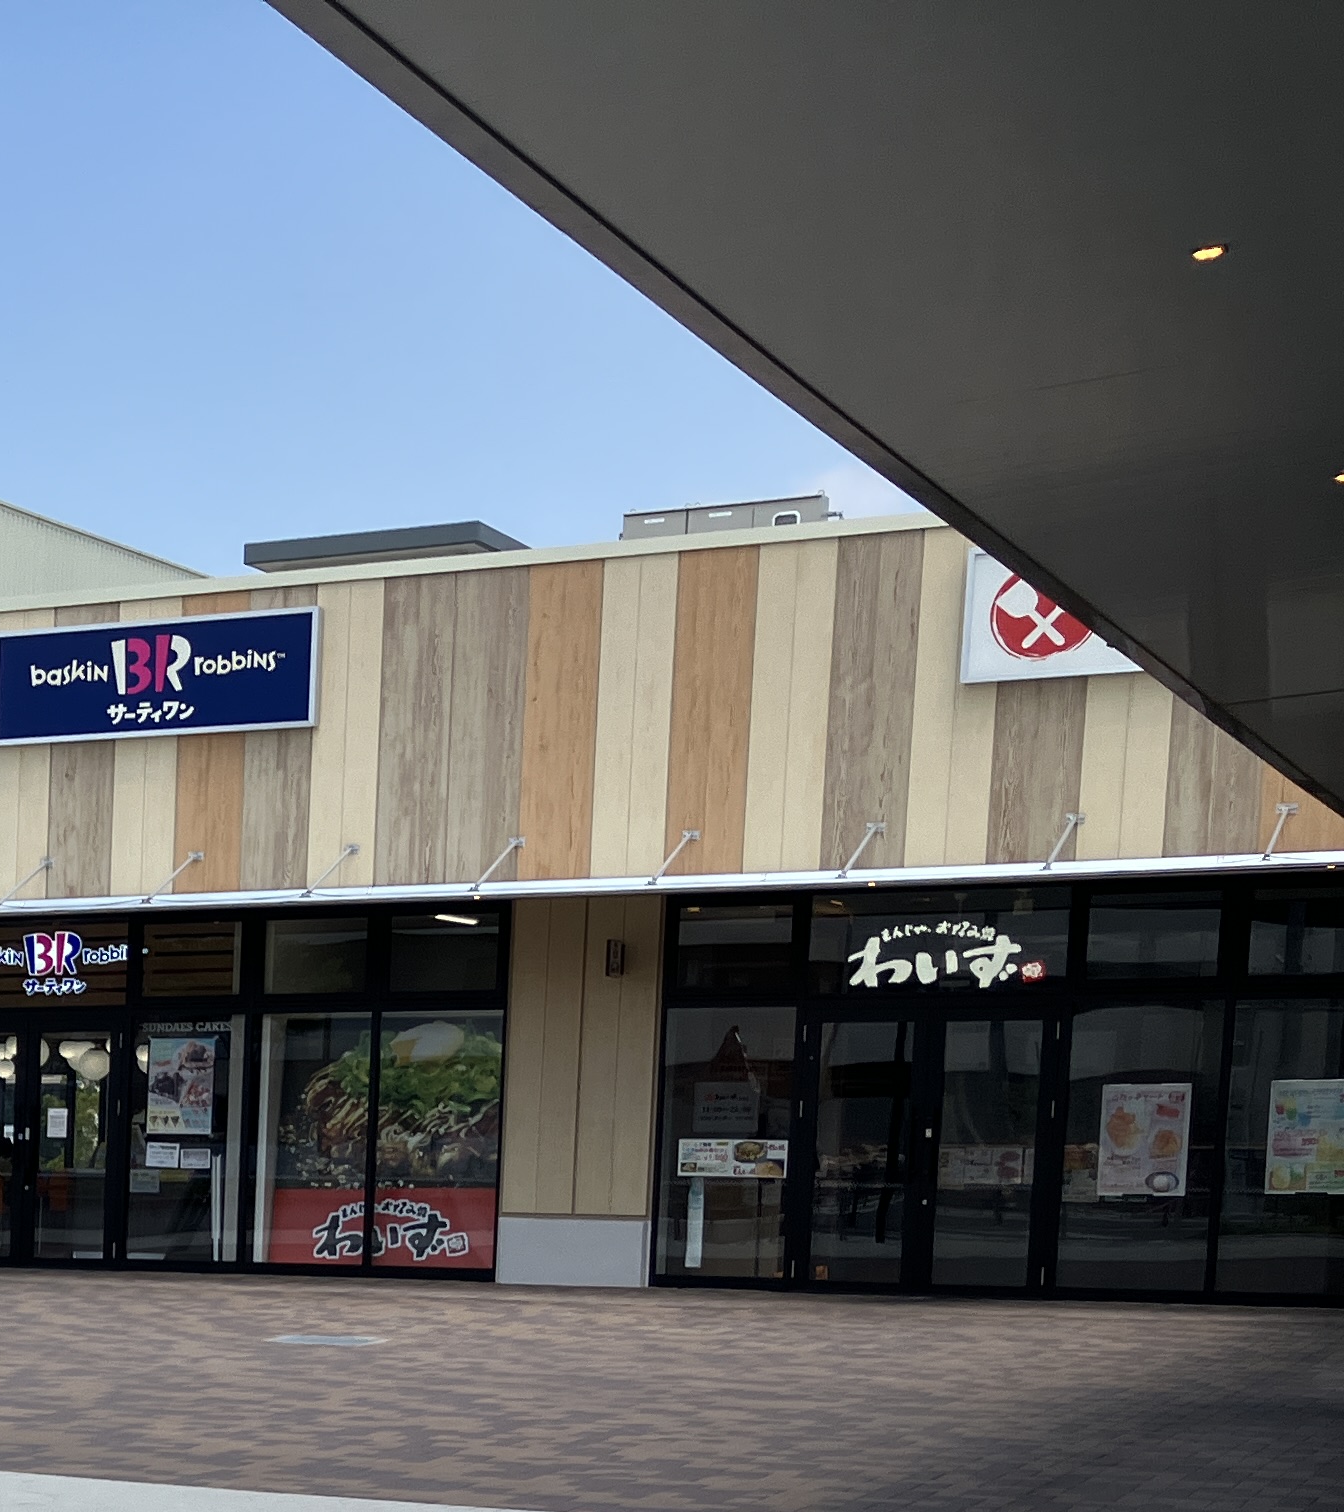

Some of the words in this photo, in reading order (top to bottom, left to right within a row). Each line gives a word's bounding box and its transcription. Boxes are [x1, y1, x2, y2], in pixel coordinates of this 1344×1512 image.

[106, 700, 195, 725] サーティワン
[81, 944, 129, 966] robbi
[847, 934, 1023, 988] わいず
[22, 977, 87, 997] サーティワン
